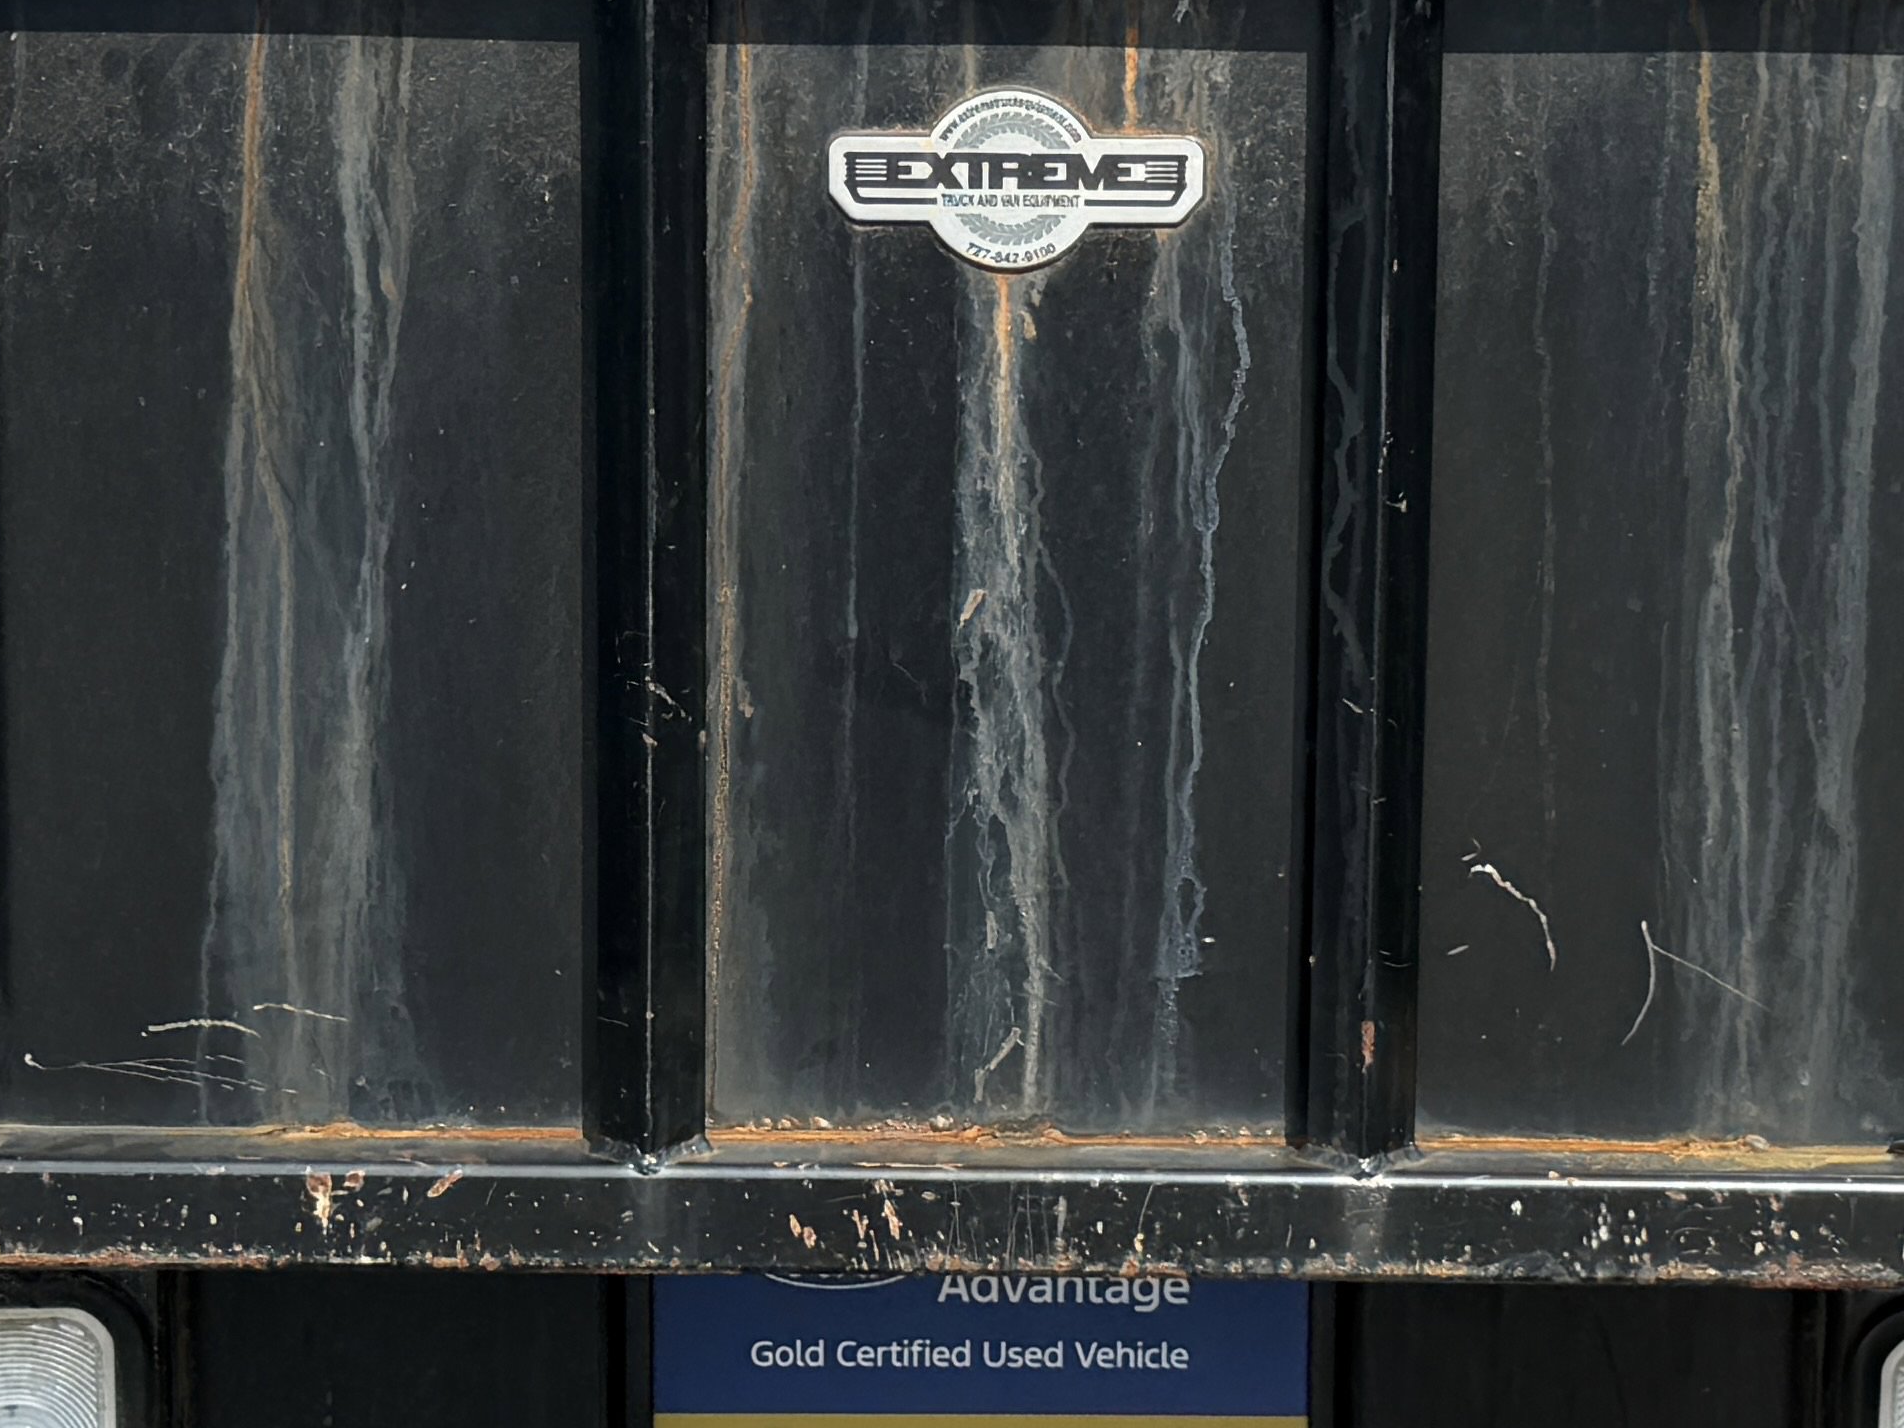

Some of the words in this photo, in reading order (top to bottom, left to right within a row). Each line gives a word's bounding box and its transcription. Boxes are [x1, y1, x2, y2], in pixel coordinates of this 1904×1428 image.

[844, 151, 1189, 190] EXTREME
[978, 194, 998, 207] AND
[937, 1275, 1191, 1312] Advantage
[750, 1340, 825, 1368] Gold
[836, 1340, 972, 1368] Certified
[983, 1341, 1063, 1368] Used
[1075, 1341, 1190, 1369] Vehicle
